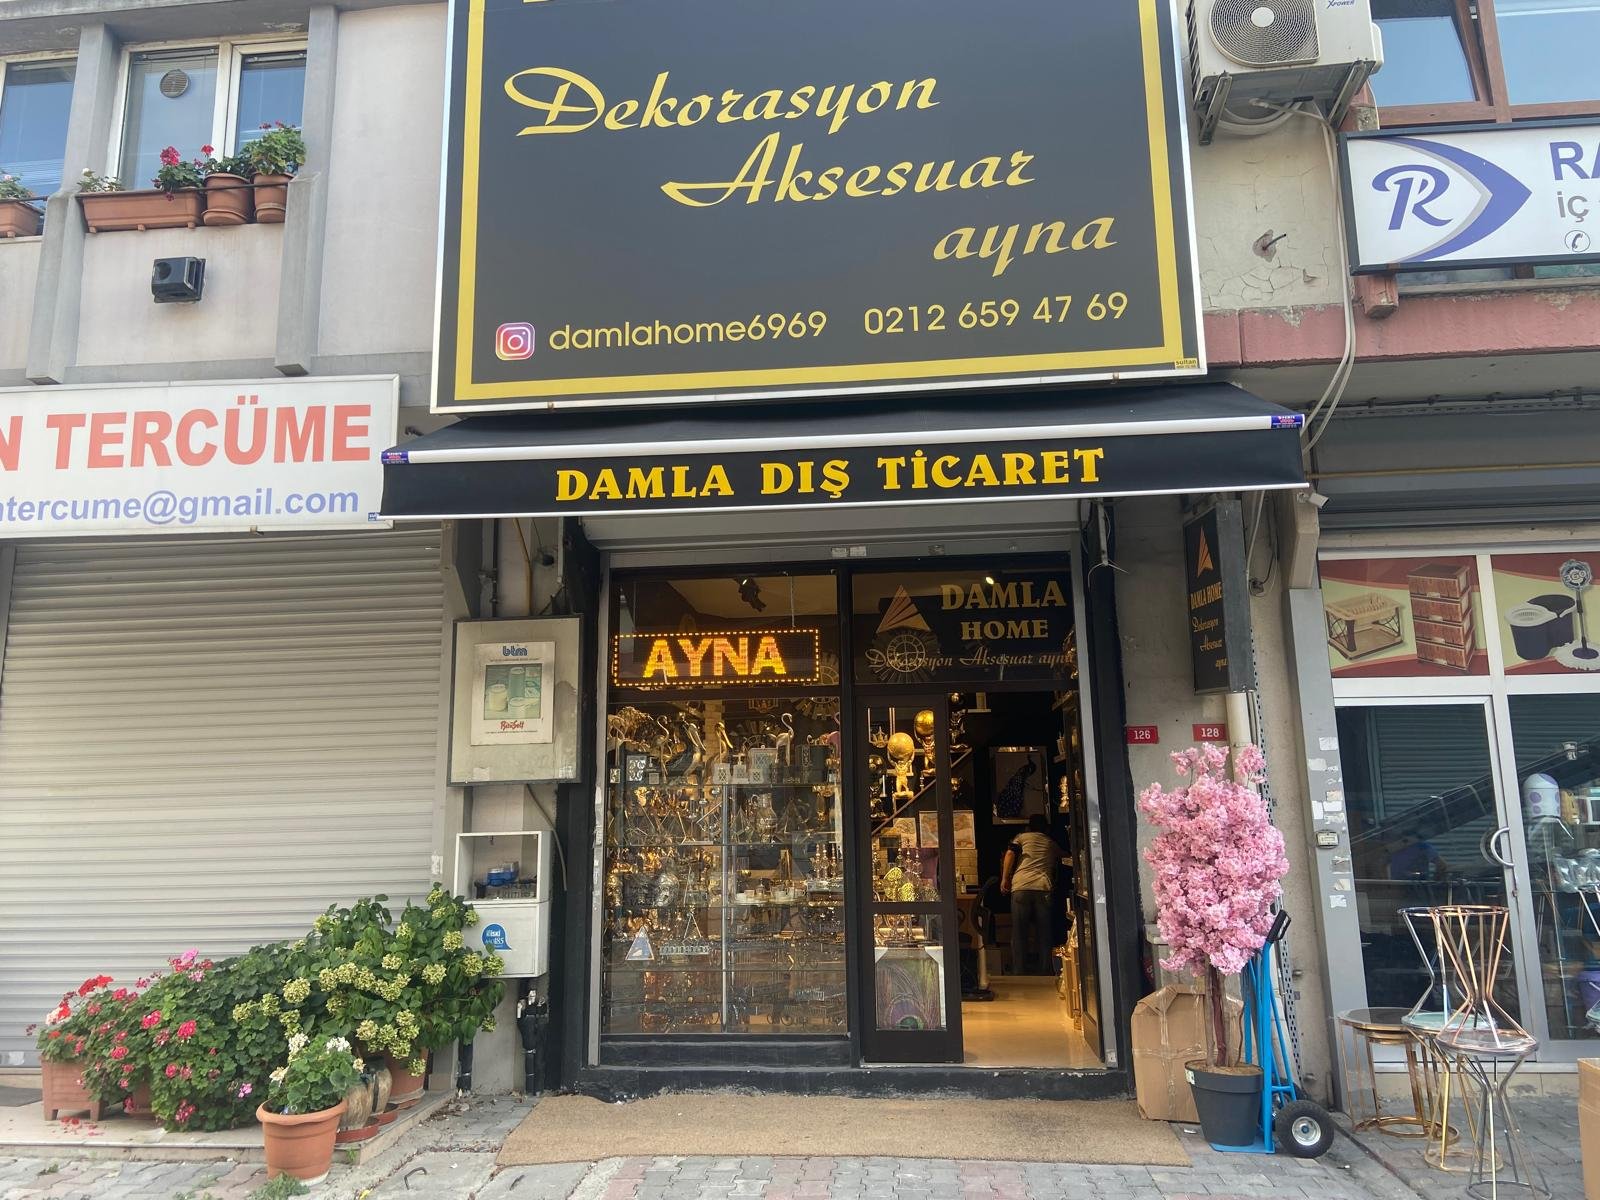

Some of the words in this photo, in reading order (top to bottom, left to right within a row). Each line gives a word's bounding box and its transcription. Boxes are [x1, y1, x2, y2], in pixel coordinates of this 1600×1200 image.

[504, 66, 940, 136] Dekorasyon
[661, 131, 1035, 208] Aksesuar
[1549, 141, 1600, 181] R
[933, 216, 1118, 277] ayna
[549, 310, 828, 351] damlahome6969
[864, 303, 946, 335] 0212
[958, 299, 1020, 330] 659
[1032, 296, 1073, 323] 47
[1086, 291, 1129, 321] 69
[46, 394, 371, 470] TERCÜME
[556, 464, 734, 502] DAMLA
[760, 457, 850, 500] DIŞ
[877, 447, 1106, 490] TİCARET
[0, 487, 359, 525] tercume@gmail.com
[940, 580, 1067, 610] DAMLA
[960, 619, 1049, 640] HOME
[642, 635, 787, 678] AYNA
[1134, 730, 1151, 740] 126
[1201, 727, 1220, 738] 128
